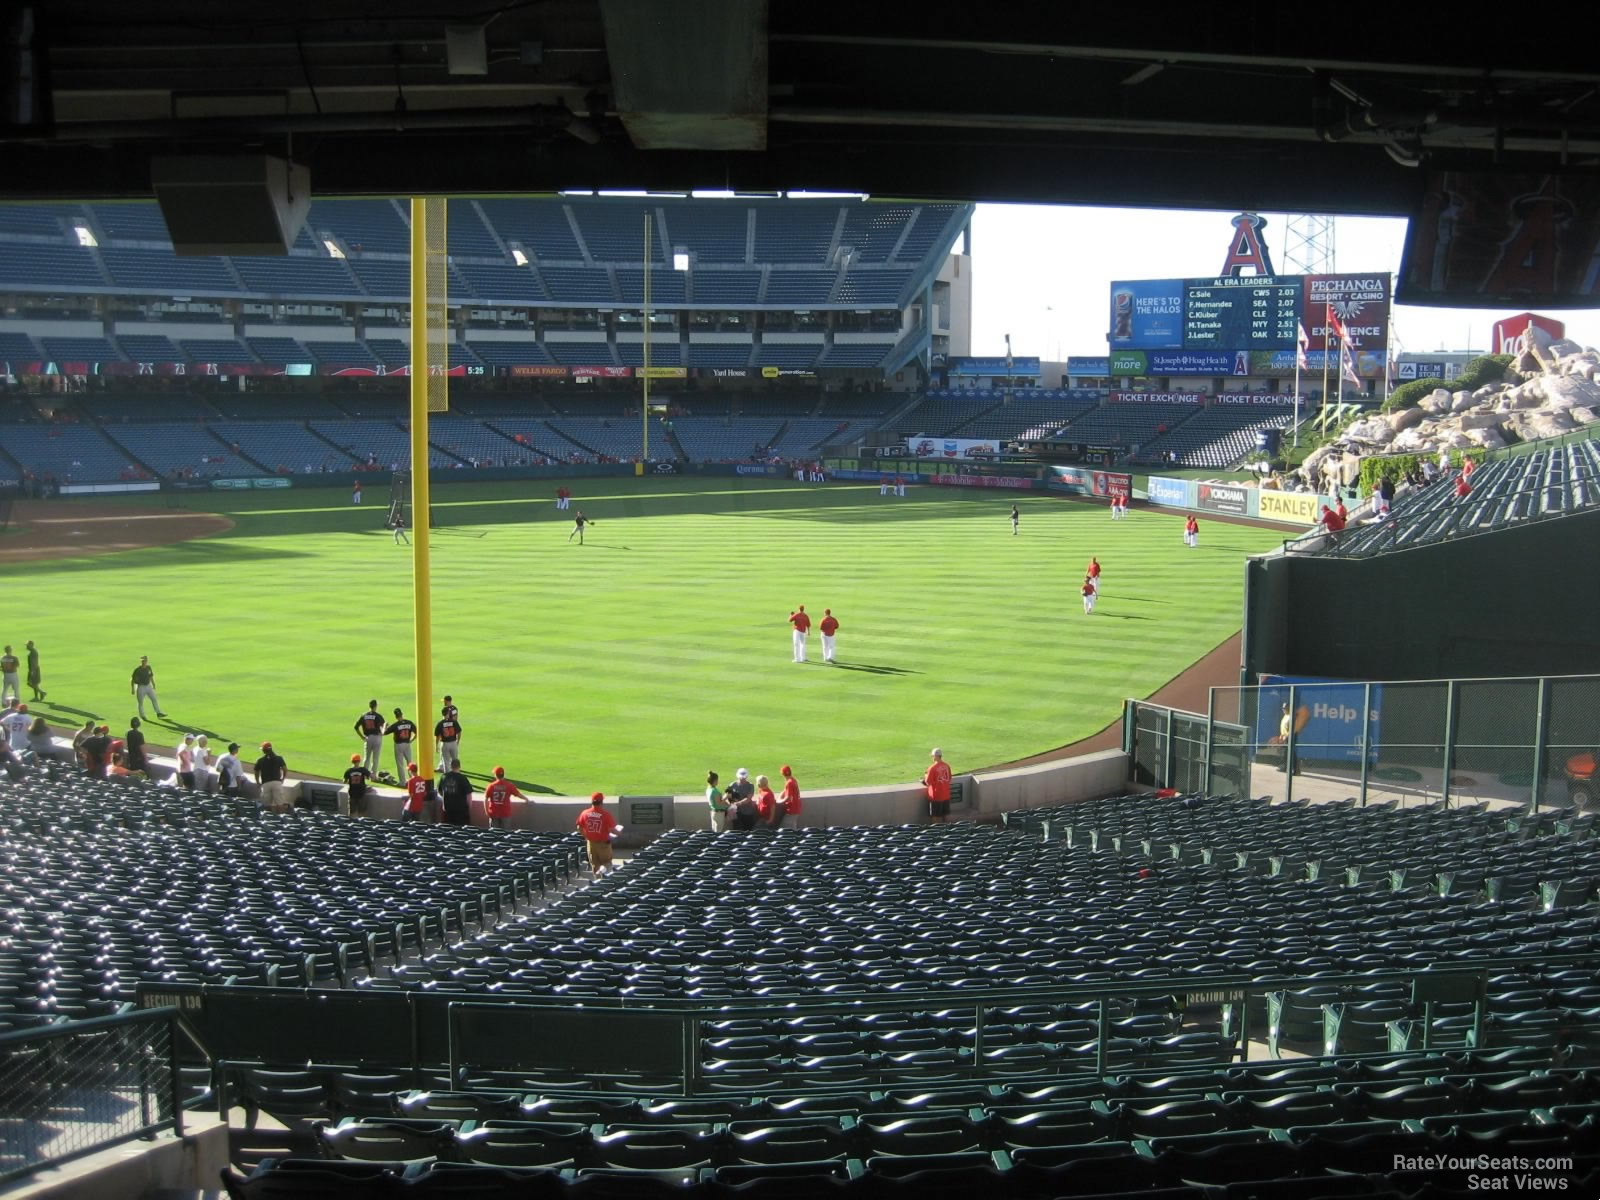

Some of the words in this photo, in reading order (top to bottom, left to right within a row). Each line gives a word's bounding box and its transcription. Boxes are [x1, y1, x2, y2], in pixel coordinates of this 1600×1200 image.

[1311, 279, 1383, 291] PECHANGA
[1136, 297, 1167, 306] HERE'S
[1167, 296, 1181, 305] TO
[1310, 293, 1343, 301] RESORT
[1350, 292, 1384, 300] CASINO
[1136, 306, 1151, 314] THE
[1152, 305, 1181, 314] HALOS
[1188, 311, 1219, 319] C.Kluber
[1252, 310, 1267, 318] CLE
[1252, 320, 1268, 328] NYY
[1277, 320, 1294, 328] 2.51
[1113, 361, 1141, 369] more
[1188, 357, 1206, 366] Hoag
[1206, 356, 1228, 364] Health
[467, 366, 485, 375] 5:25
[515, 367, 541, 375] WELLS
[542, 367, 566, 375] FARGO
[713, 369, 727, 377] Yard
[727, 369, 746, 377] House
[1117, 393, 1148, 402] TICKET
[1217, 394, 1251, 404] TICKET
[1156, 485, 1185, 499] Experian
[1210, 488, 1245, 502] YOKOHAMA
[1260, 497, 1316, 517] STANLEY
[1314, 703, 1357, 723] Help
[415, 781, 426, 793] 25
[493, 791, 506, 802] 27
[587, 819, 602, 833] 27
[143, 994, 181, 1009] SECTION
[1190, 991, 1225, 1003] SECTION
